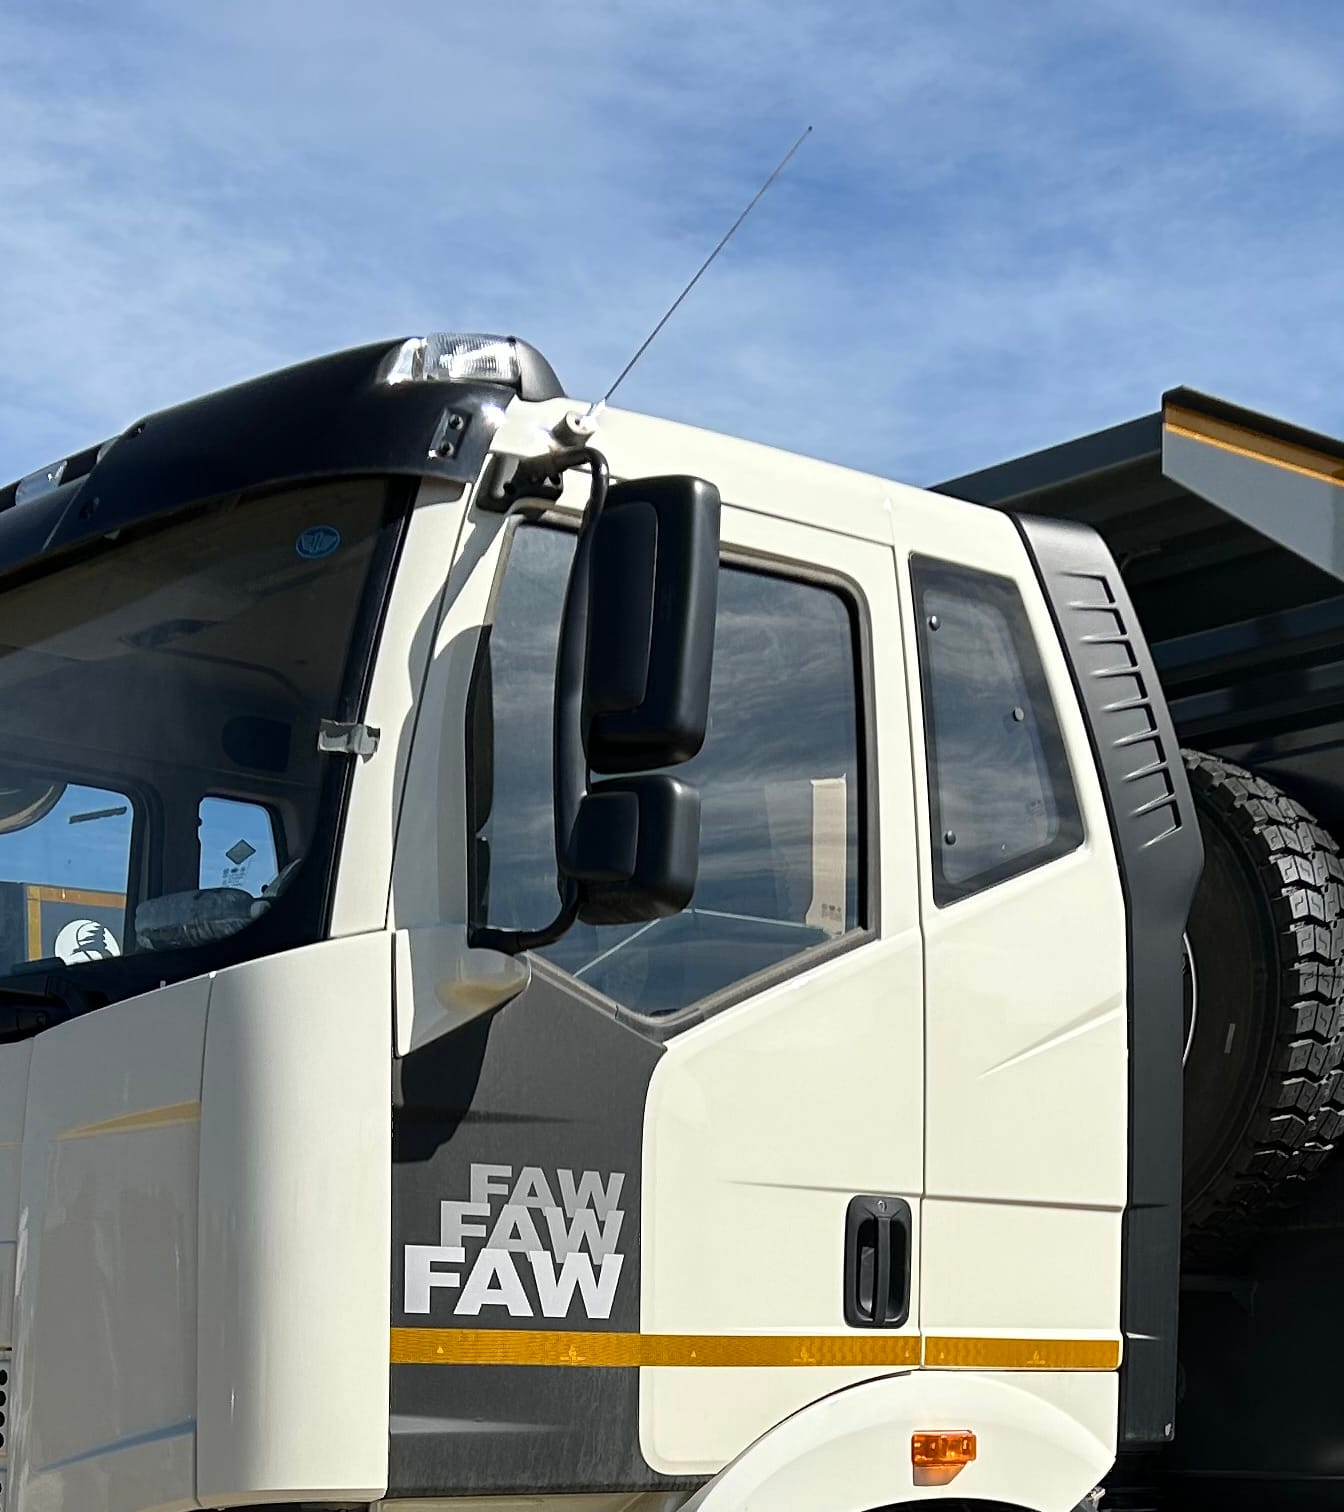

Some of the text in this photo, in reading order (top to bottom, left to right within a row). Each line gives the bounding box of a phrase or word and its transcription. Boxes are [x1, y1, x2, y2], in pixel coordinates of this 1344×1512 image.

[470, 1163, 626, 1222] FAW
[440, 1200, 626, 1266] FAW
[403, 1244, 626, 1320] FAW
